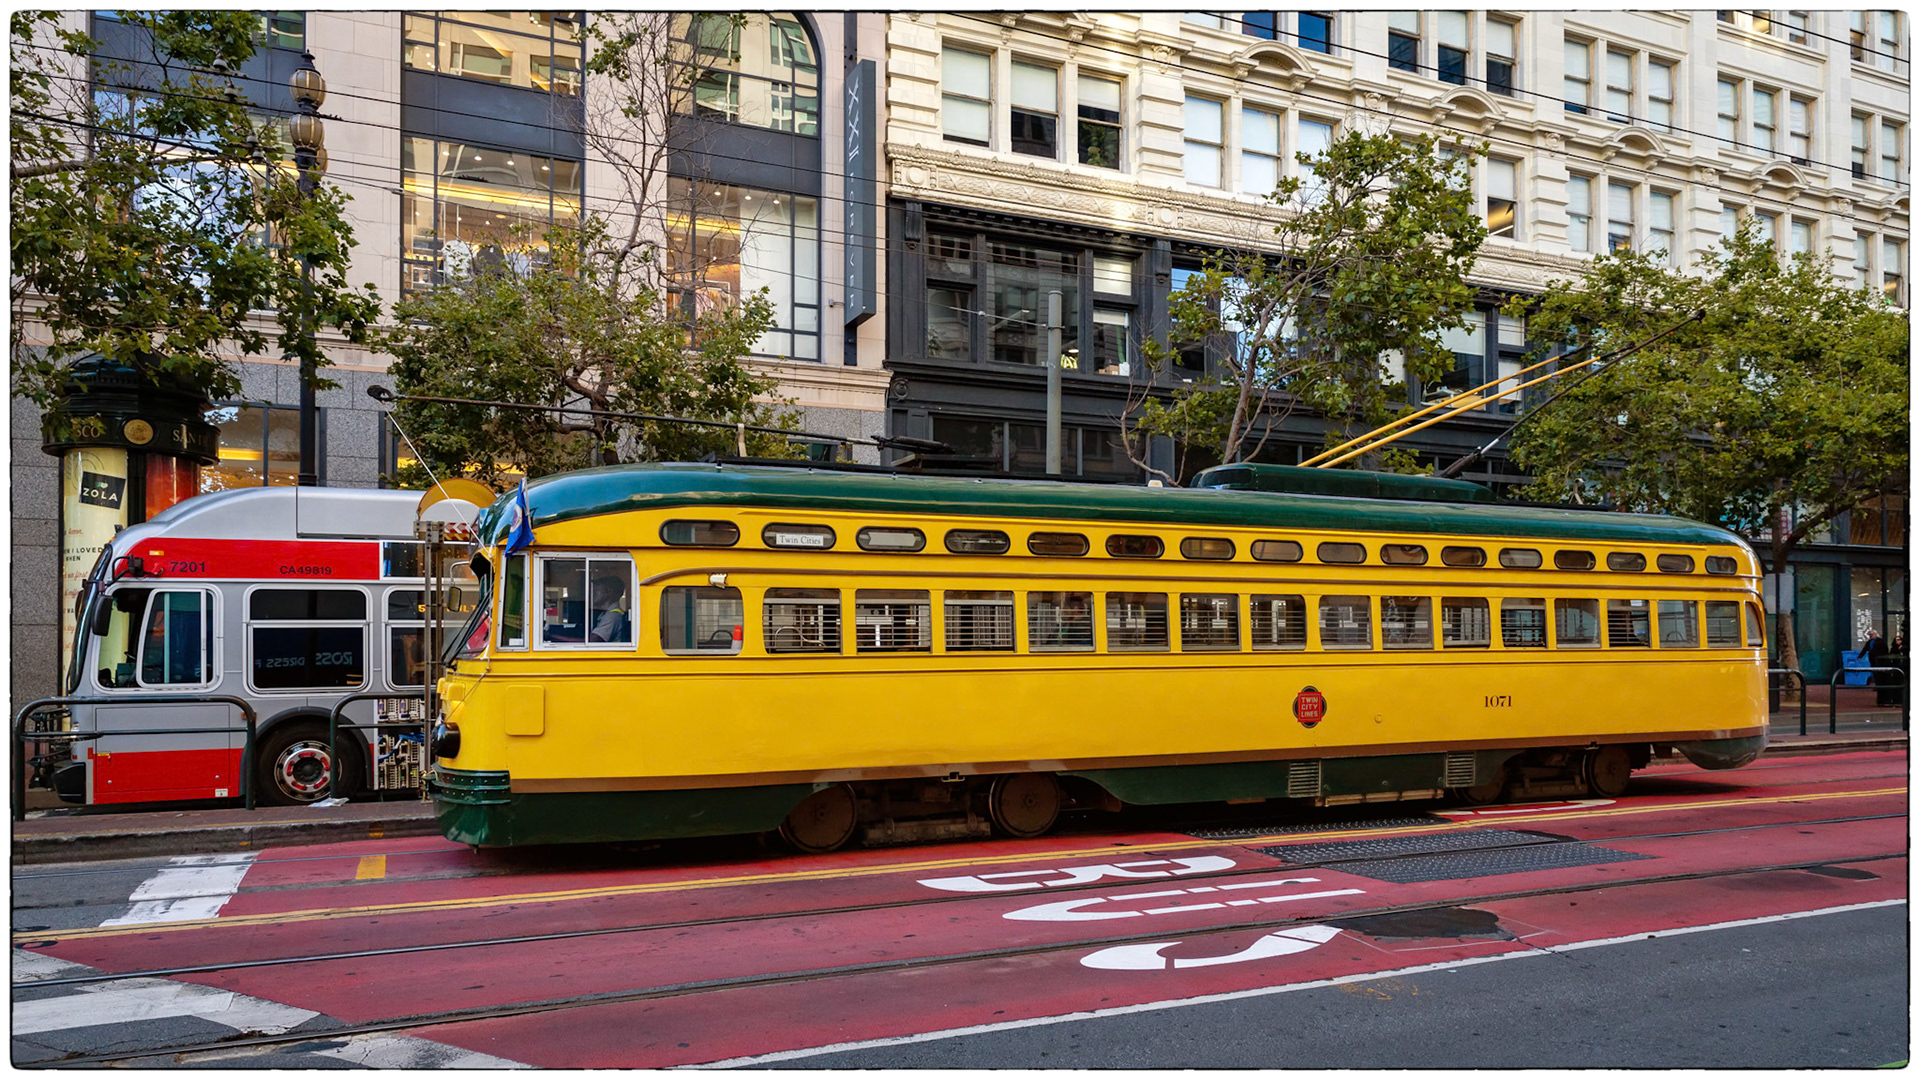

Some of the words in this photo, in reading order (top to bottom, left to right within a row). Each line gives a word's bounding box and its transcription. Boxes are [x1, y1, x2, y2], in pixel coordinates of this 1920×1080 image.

[83, 487, 118, 502] ZOLA
[780, 535, 799, 544] Twin
[801, 536, 821, 545] Cities
[76, 546, 104, 554] LOVED
[169, 561, 206, 573] 7201
[279, 565, 332, 575] CA49819
[1301, 696, 1319, 704] TWIN
[1484, 695, 1512, 708] 1071
[1301, 703, 1318, 711] CITY
